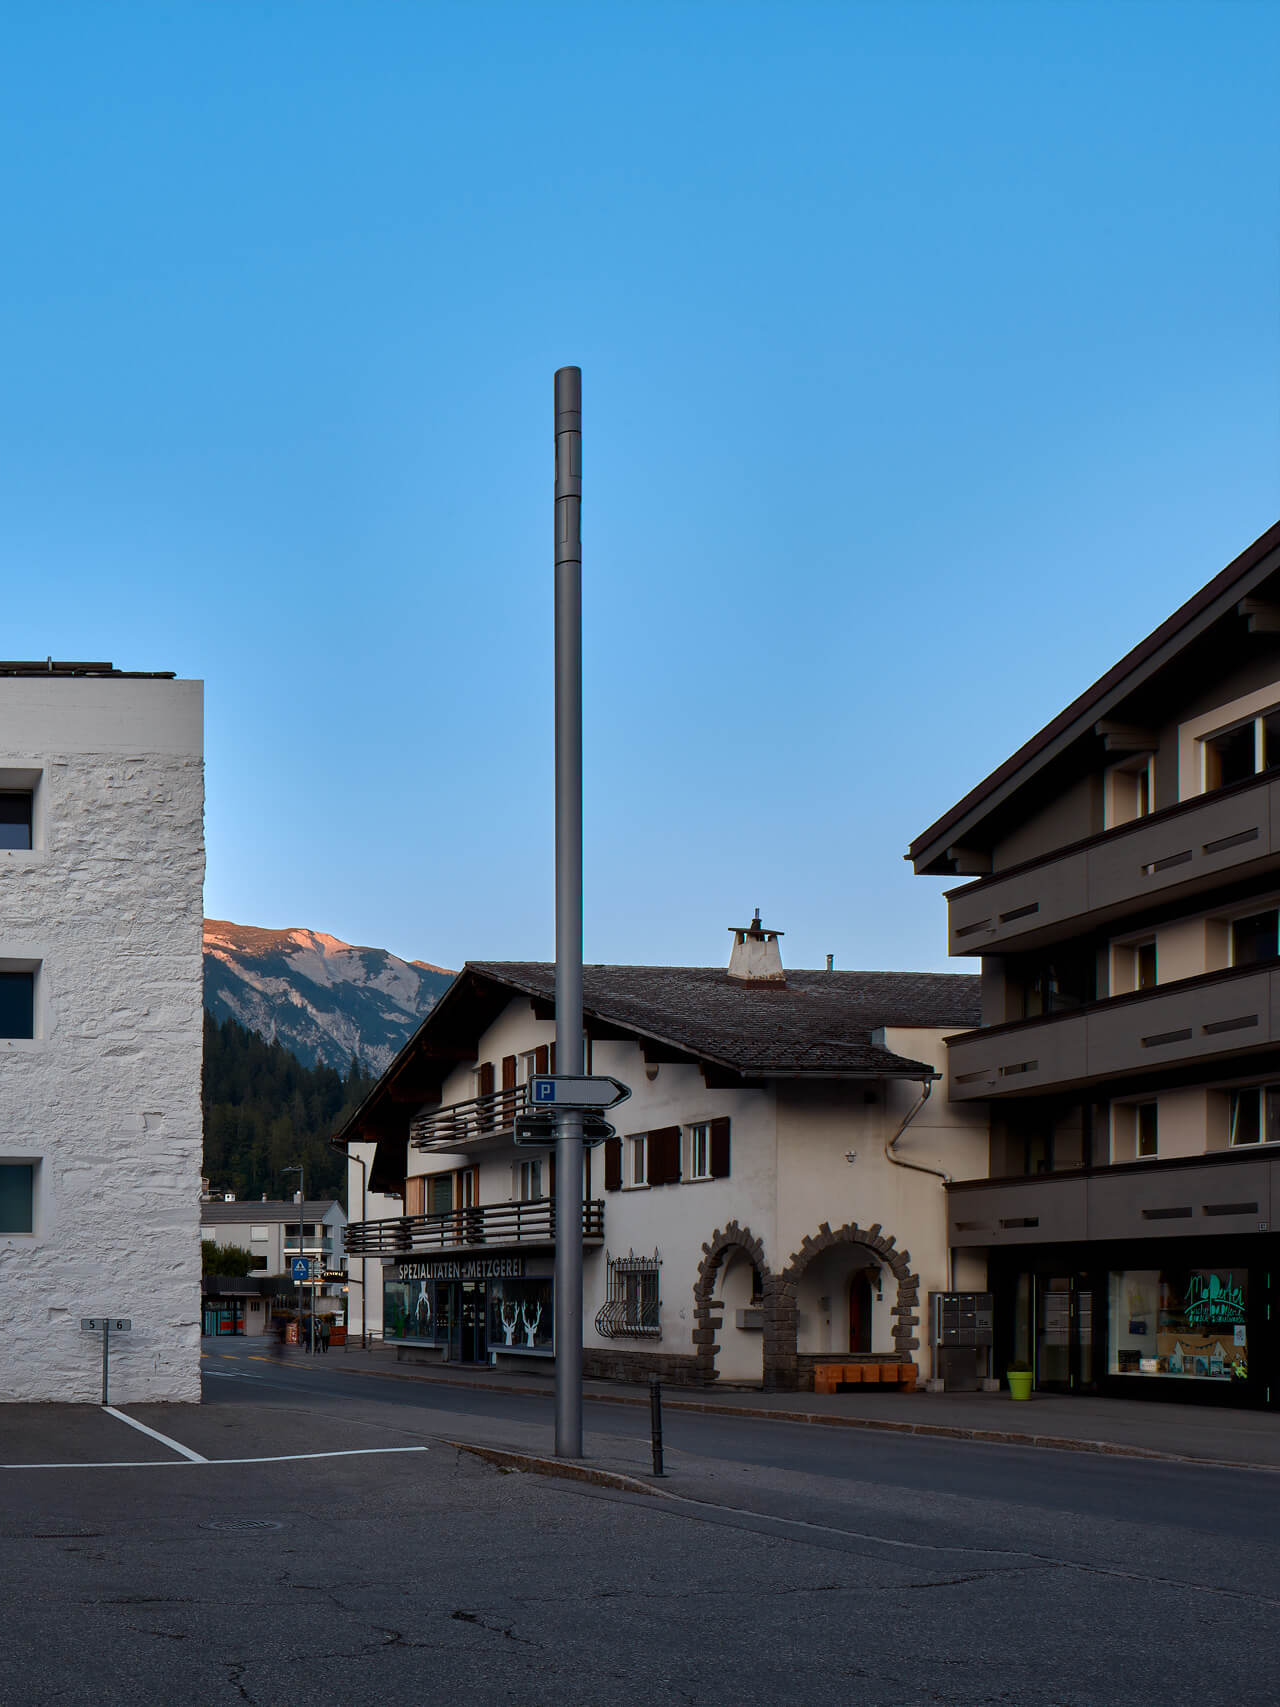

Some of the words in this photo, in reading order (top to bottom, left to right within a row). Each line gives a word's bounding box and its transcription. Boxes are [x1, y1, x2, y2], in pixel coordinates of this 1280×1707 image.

[540, 1084, 551, 1099] P
[89, 1319, 95, 1329] 5
[117, 1320, 122, 1329] 6
